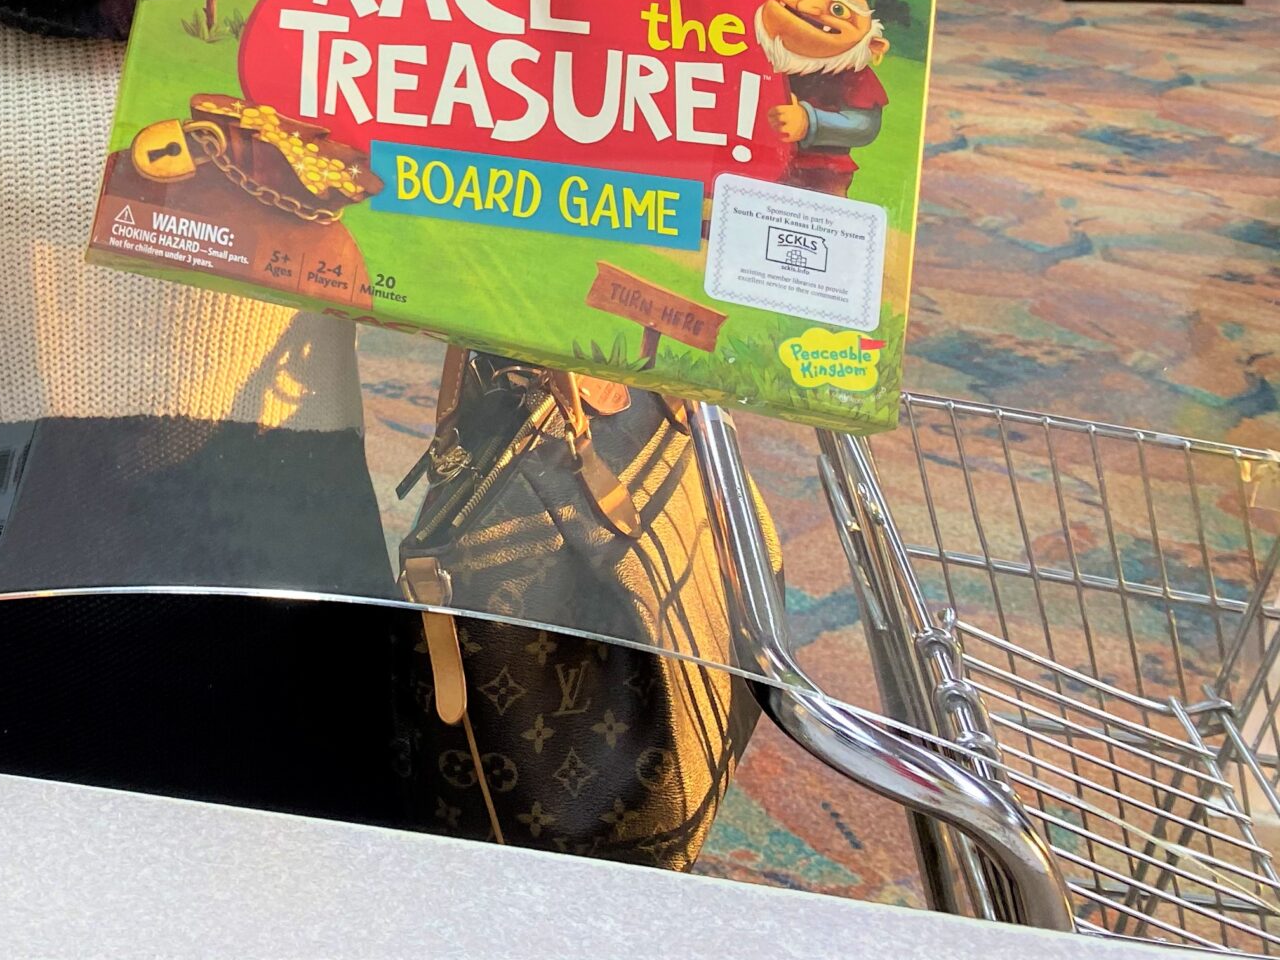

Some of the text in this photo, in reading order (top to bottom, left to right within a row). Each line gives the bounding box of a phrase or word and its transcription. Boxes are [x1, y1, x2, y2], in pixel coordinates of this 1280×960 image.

[278, 8, 762, 163] TREASURE!
[395, 154, 680, 237] BOARD GAME
[733, 207, 865, 241] South Central Kansas Library System
[767, 206, 801, 219] Sponsored
[810, 215, 824, 224] part
[825, 218, 834, 226] by
[152, 212, 235, 247] WARNING:
[111, 224, 156, 243] CHOKING
[228, 253, 249, 265] parts.
[777, 233, 818, 251] SCKLS
[109, 237, 214, 268] Not for children under 3 years.
[270, 250, 291, 265] 5+
[265, 262, 293, 278] Ages
[316, 261, 342, 276] 2-4
[307, 271, 349, 290] Players
[375, 273, 396, 289] 20
[360, 283, 408, 303] Minutes
[611, 282, 705, 336] TURN HERE
[790, 339, 871, 363] Peaceable
[800, 361, 866, 378] Kingdom
